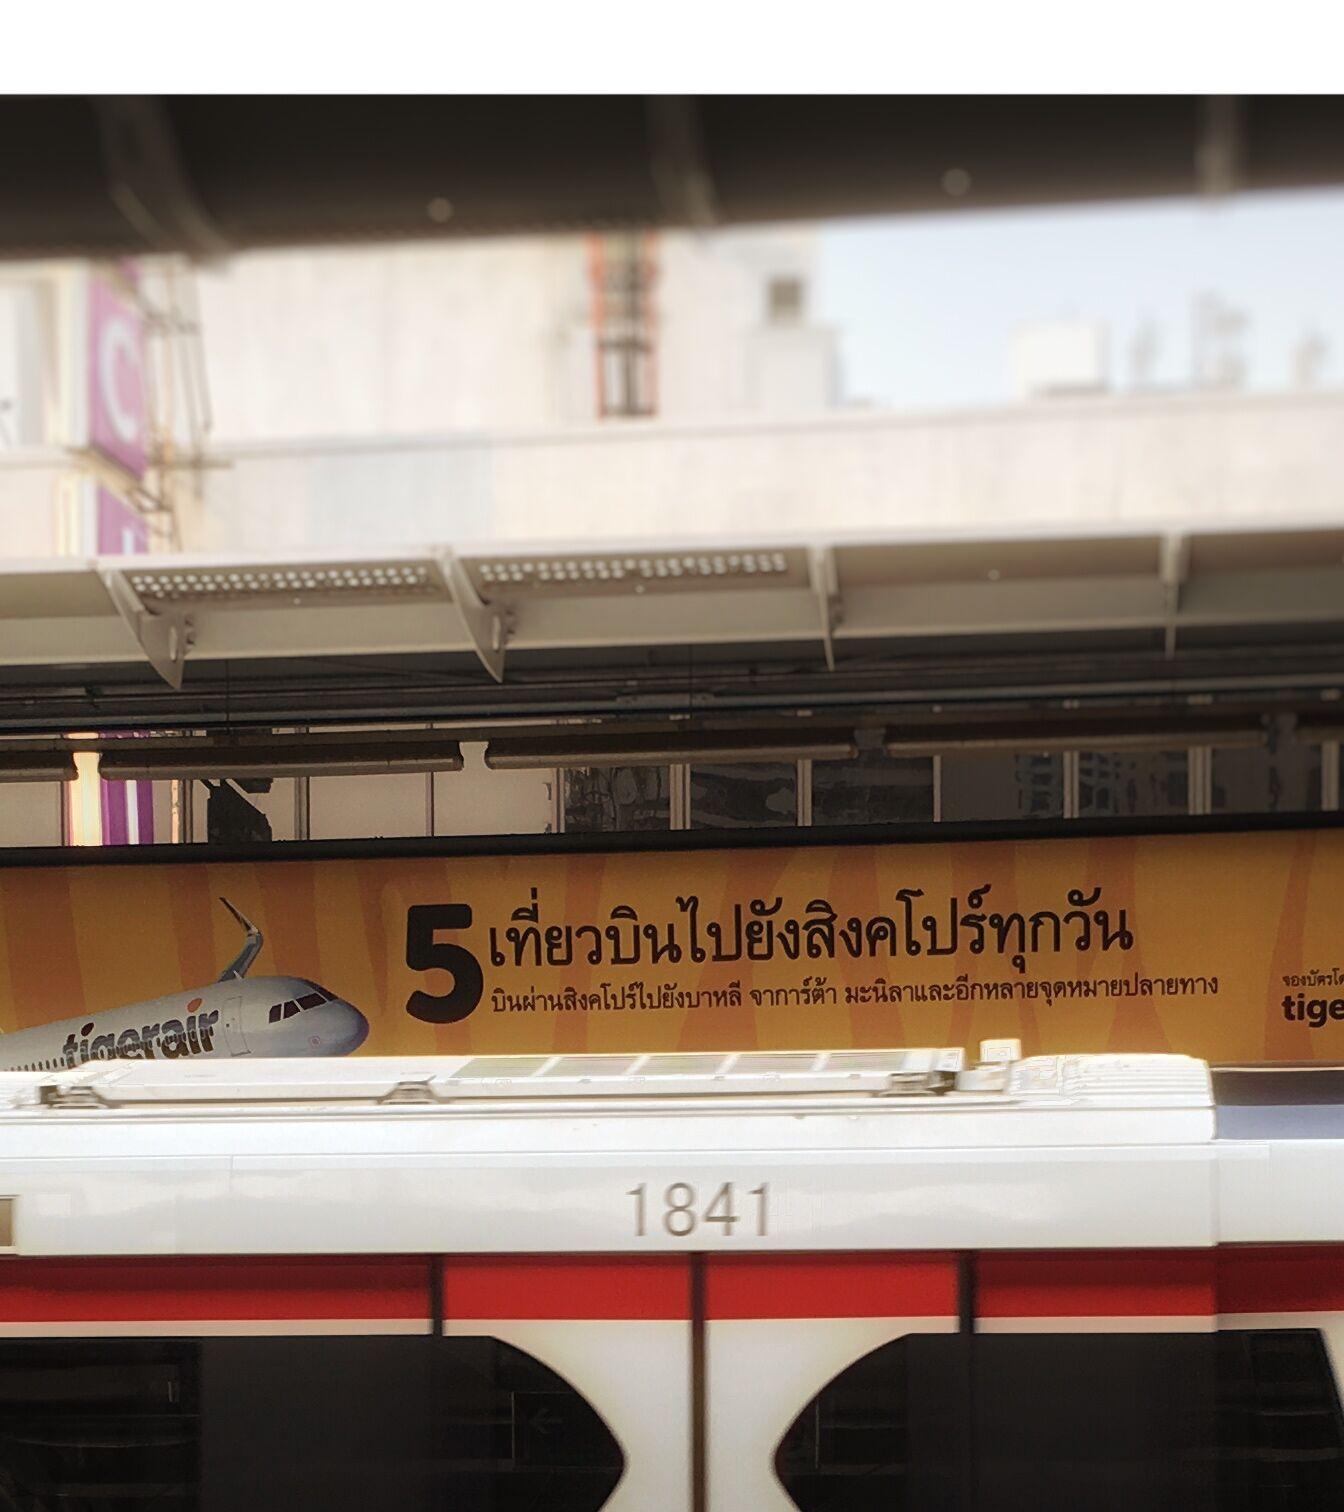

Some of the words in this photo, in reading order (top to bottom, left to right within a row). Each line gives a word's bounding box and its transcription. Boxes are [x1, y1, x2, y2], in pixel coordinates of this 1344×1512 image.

[405, 903, 484, 1025] 5
[489, 884, 1133, 974] เที่ยวบินไปยังสิงคโปร์ทุกวัน
[626, 1182, 770, 1237] 1841
